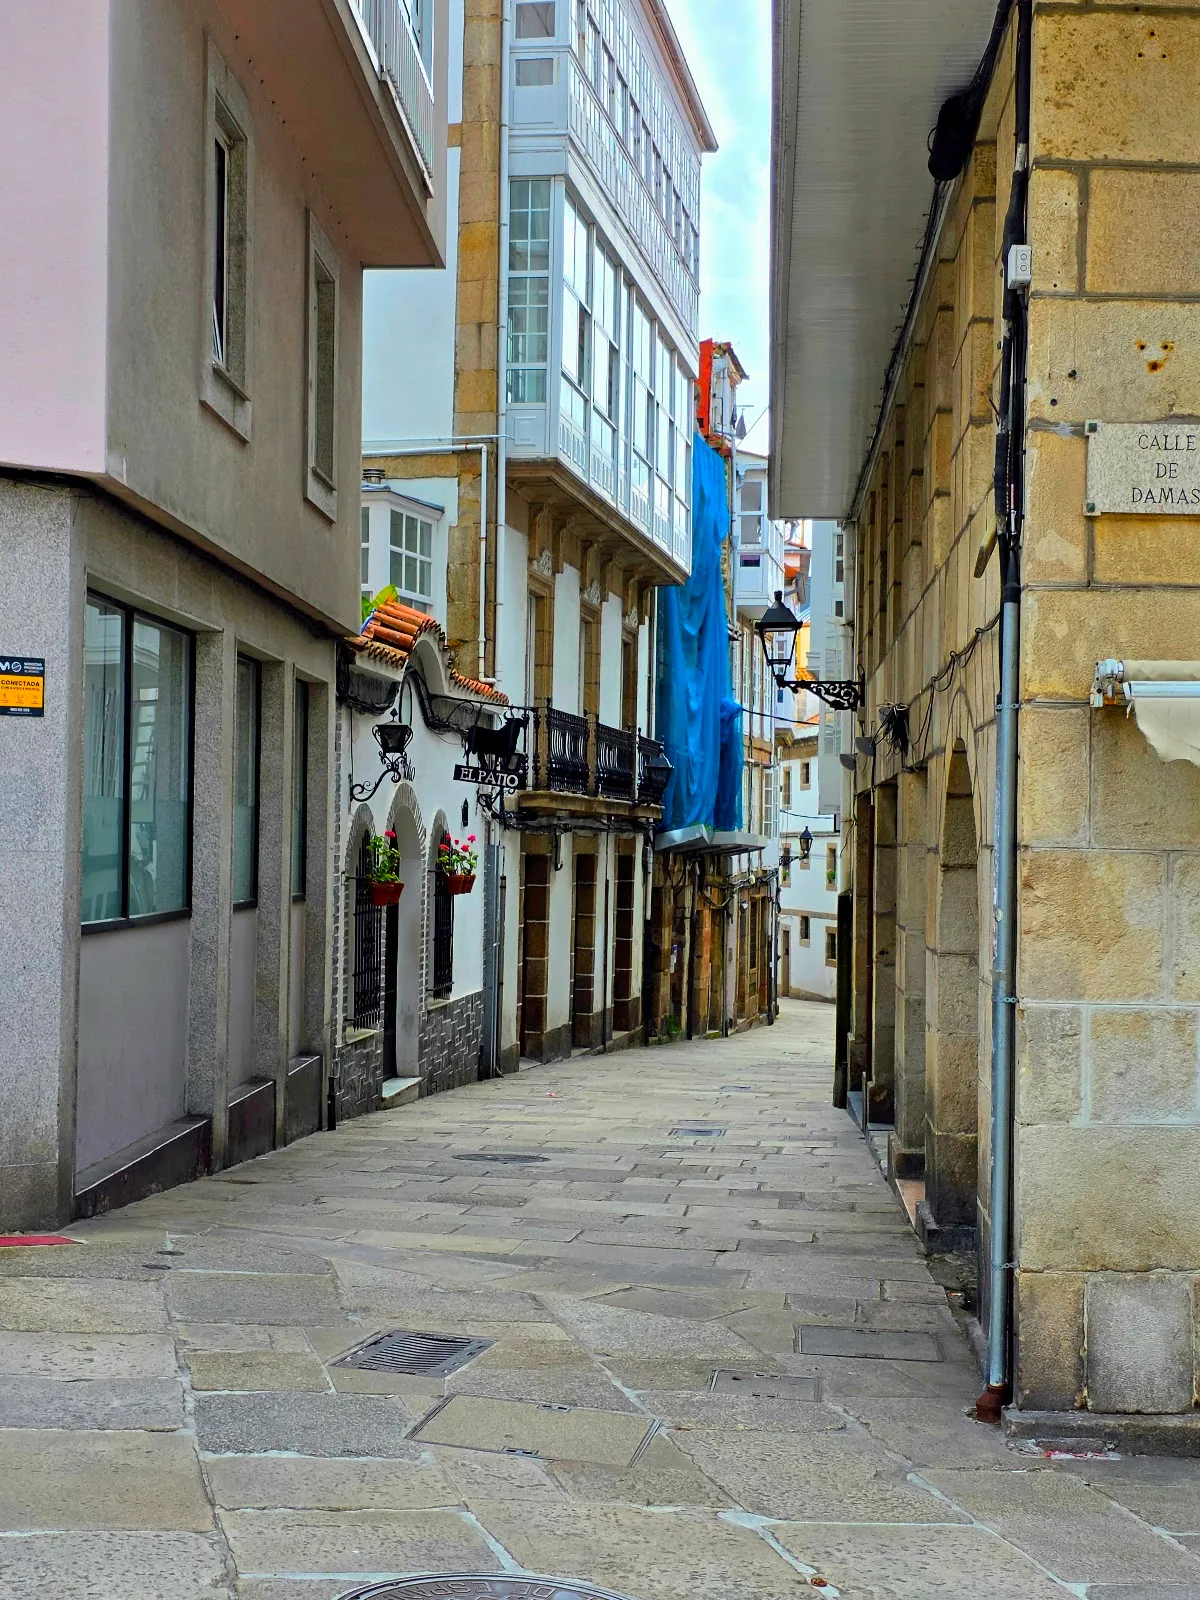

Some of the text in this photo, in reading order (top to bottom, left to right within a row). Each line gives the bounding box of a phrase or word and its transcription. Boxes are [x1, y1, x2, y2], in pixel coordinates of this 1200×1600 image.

[1138, 434, 1197, 451] CALLE
[1155, 462, 1179, 479] DE
[1131, 487, 1200, 504] DAMAS
[460, 767, 518, 788] EL PATIO
